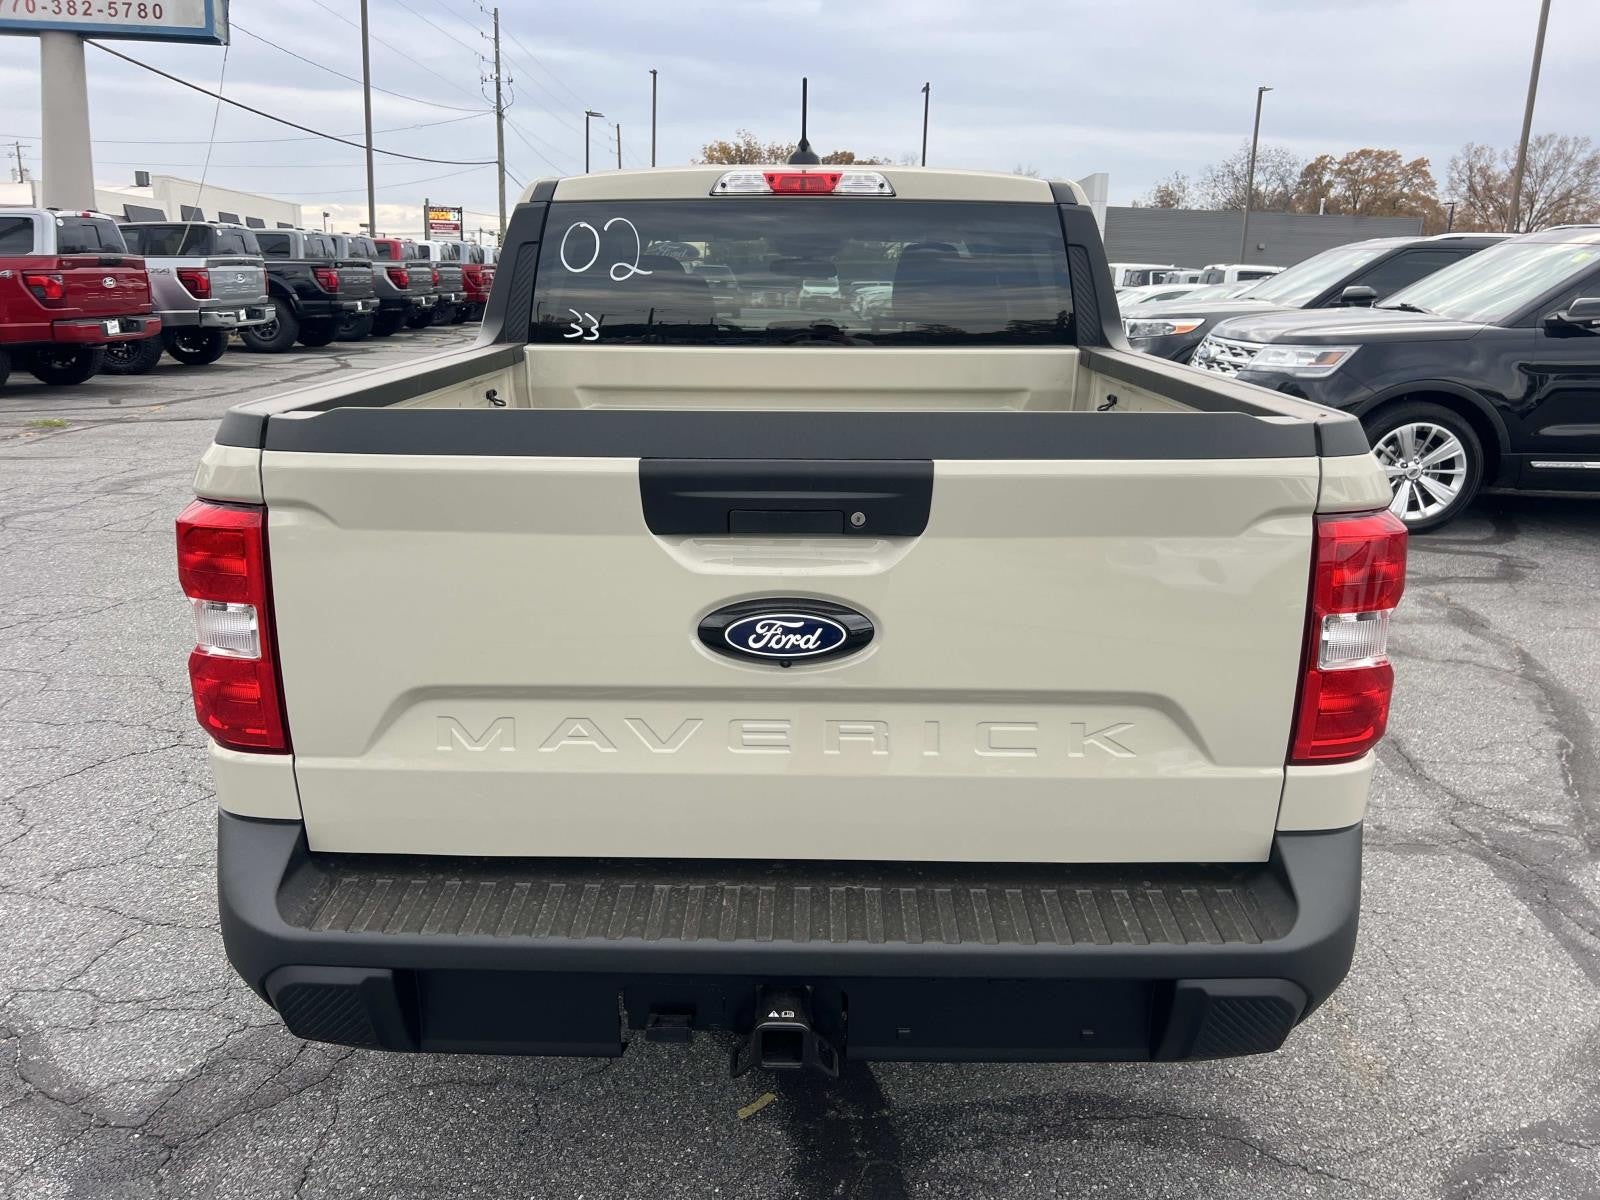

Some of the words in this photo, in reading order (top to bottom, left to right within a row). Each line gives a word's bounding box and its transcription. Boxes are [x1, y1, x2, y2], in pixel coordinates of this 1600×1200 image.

[0, 0, 163, 20] 70-382-5780
[560, 217, 653, 281] 02
[563, 308, 600, 341] 33
[748, 619, 822, 650] Ford
[436, 715, 1137, 758] MAVERICK
